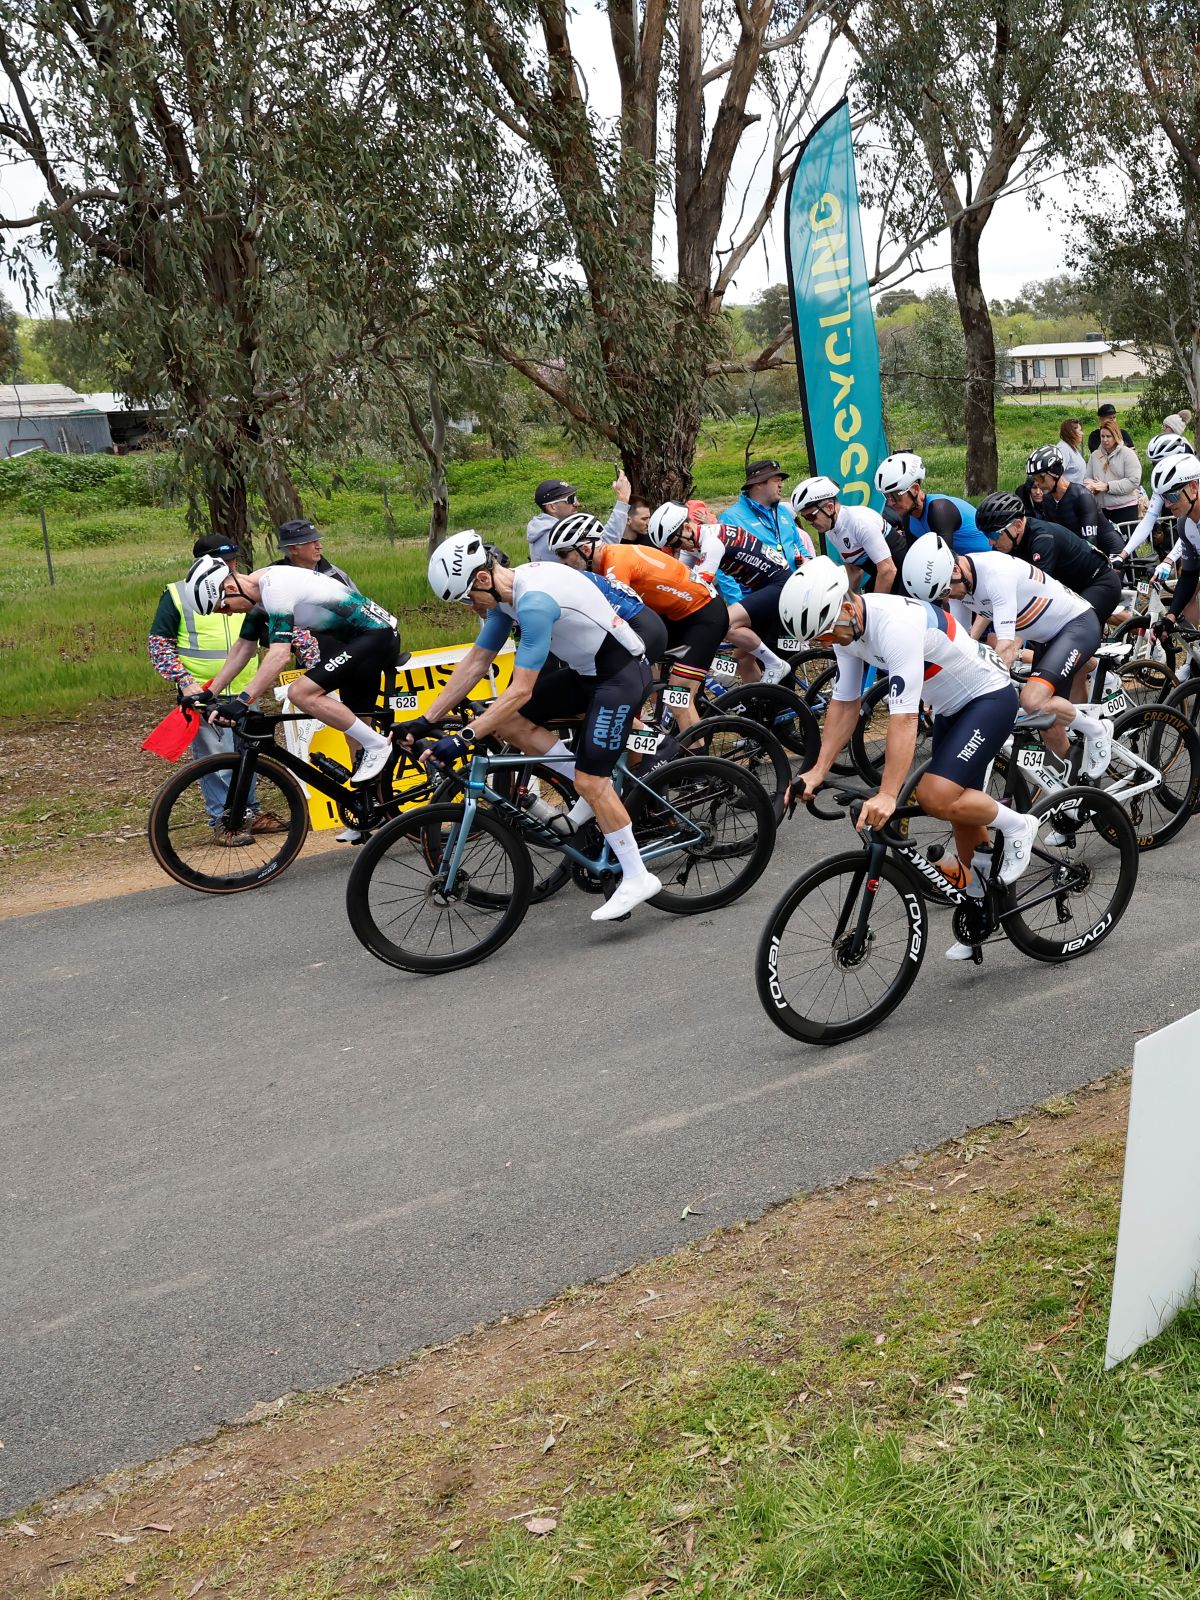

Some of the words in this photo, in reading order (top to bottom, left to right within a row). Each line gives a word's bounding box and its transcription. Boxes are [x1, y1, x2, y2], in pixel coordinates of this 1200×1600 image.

[808, 191, 870, 508] USCYCLING
[452, 544, 465, 577] KASK
[734, 552, 745, 562] ST
[744, 554, 761, 571] KILDA
[760, 562, 771, 573] CC
[924, 560, 934, 584] KASK
[655, 584, 694, 602] cervélo
[782, 639, 799, 649] 627
[324, 650, 353, 672] efex
[716, 659, 735, 673] 633
[396, 697, 416, 708] 628
[669, 691, 688, 706] 636
[1107, 696, 1125, 714] 600
[592, 706, 615, 749] SAINT
[608, 704, 631, 751] CLOUD
[1143, 711, 1190, 733] CREATIVE
[633, 737, 656, 751] 642
[1023, 752, 1043, 767] 634
[1037, 797, 1084, 829] oval
[899, 845, 968, 906] S-WORKS
[905, 893, 922, 963] roval
[1061, 911, 1113, 955] roval
[768, 935, 788, 1009] roval
